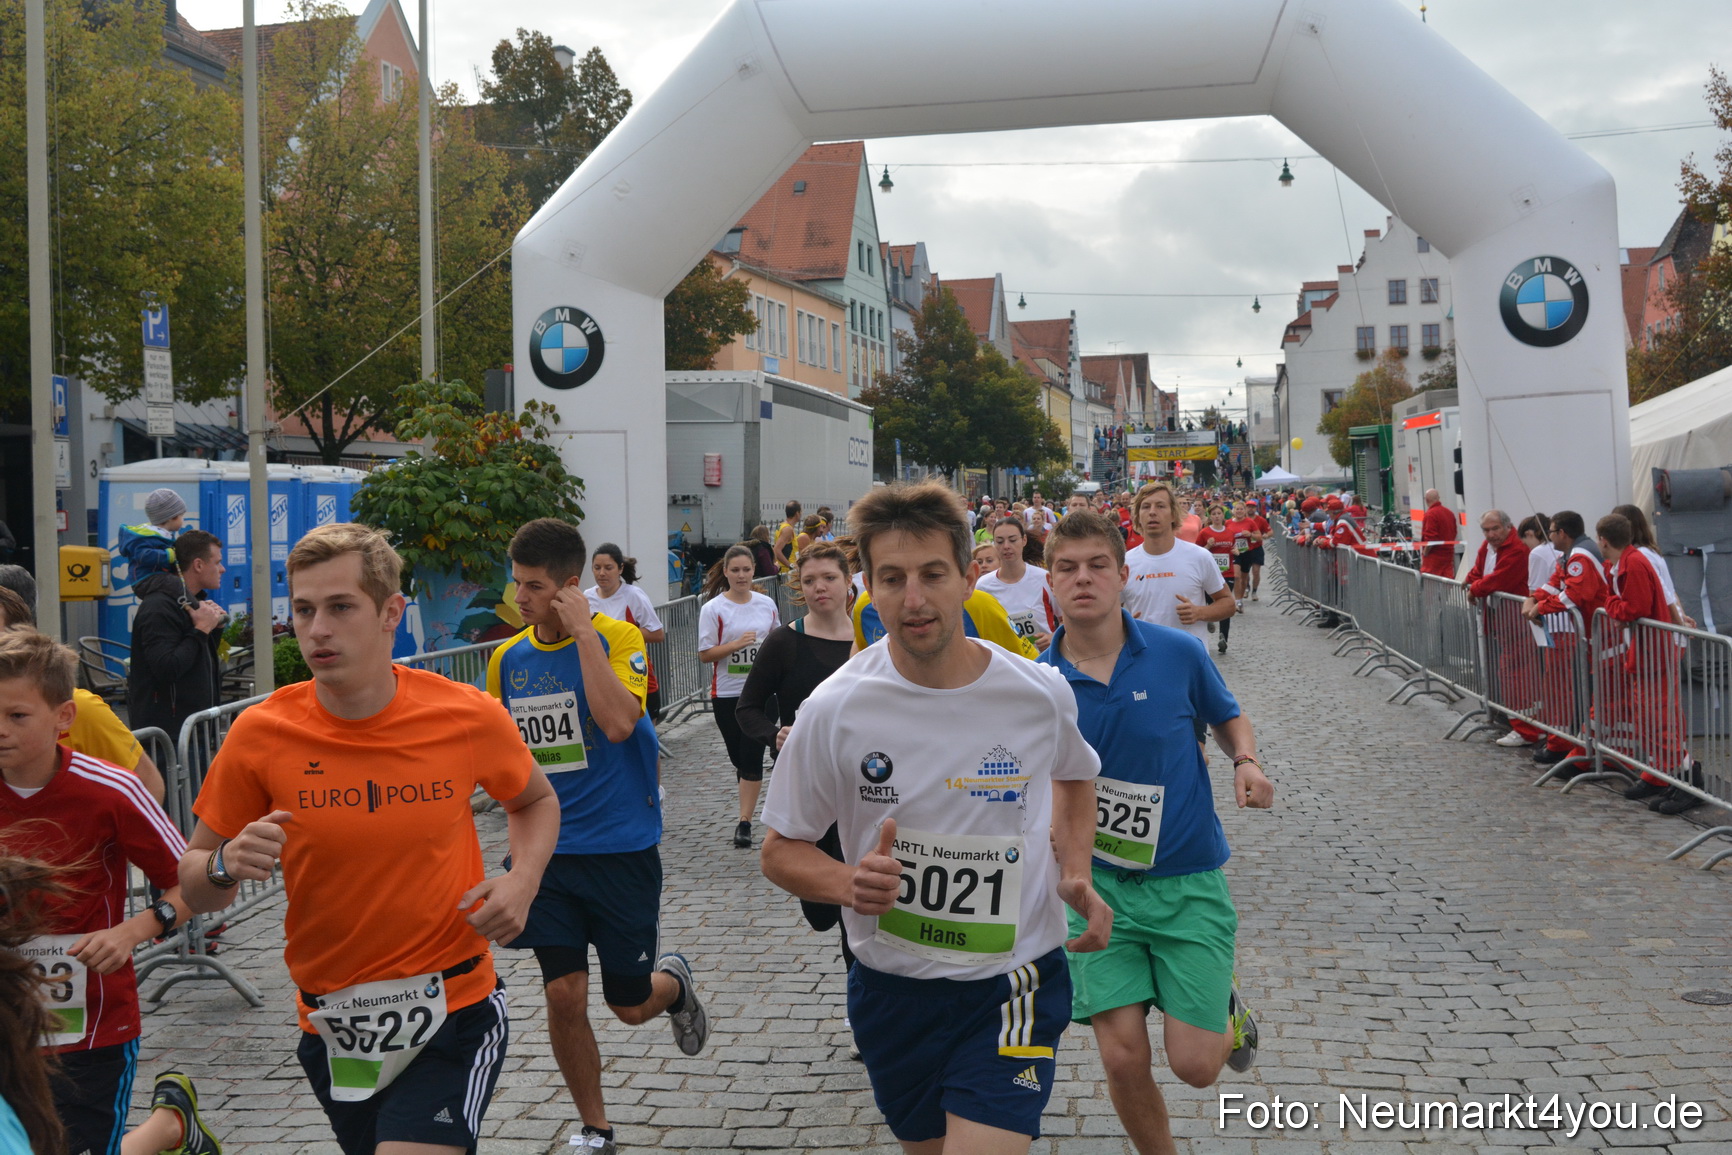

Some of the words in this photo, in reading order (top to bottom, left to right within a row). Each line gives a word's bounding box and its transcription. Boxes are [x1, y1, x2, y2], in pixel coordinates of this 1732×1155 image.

[1506, 258, 1582, 290] BMW
[148, 301, 163, 340] P
[534, 308, 598, 336] BMW
[1156, 449, 1188, 458] START
[90, 459, 98, 478] 3
[228, 498, 246, 526] DIXI
[271, 498, 288, 523] DIXI
[317, 499, 336, 522] DIXI
[1132, 690, 1148, 701] Toni
[528, 702, 563, 713] Neumarkt
[516, 712, 574, 745] 5094
[864, 752, 890, 763] BMW
[859, 785, 899, 797] PARTL
[945, 777, 968, 790] 14.
[1102, 784, 1147, 802] Neumarkt
[298, 788, 362, 809] EURO
[386, 780, 454, 805] POLES
[861, 795, 899, 805] Neumarkt
[892, 838, 929, 857] ARTL
[932, 846, 1000, 862] Neumarkt
[1095, 832, 1122, 853] oni
[894, 858, 1004, 916] 5021
[919, 922, 967, 947] Hans
[352, 989, 419, 1009] Neumarkt
[323, 1005, 433, 1054] 5522
[1012, 1077, 1042, 1092] adidas
[433, 1116, 454, 1124] adidas
